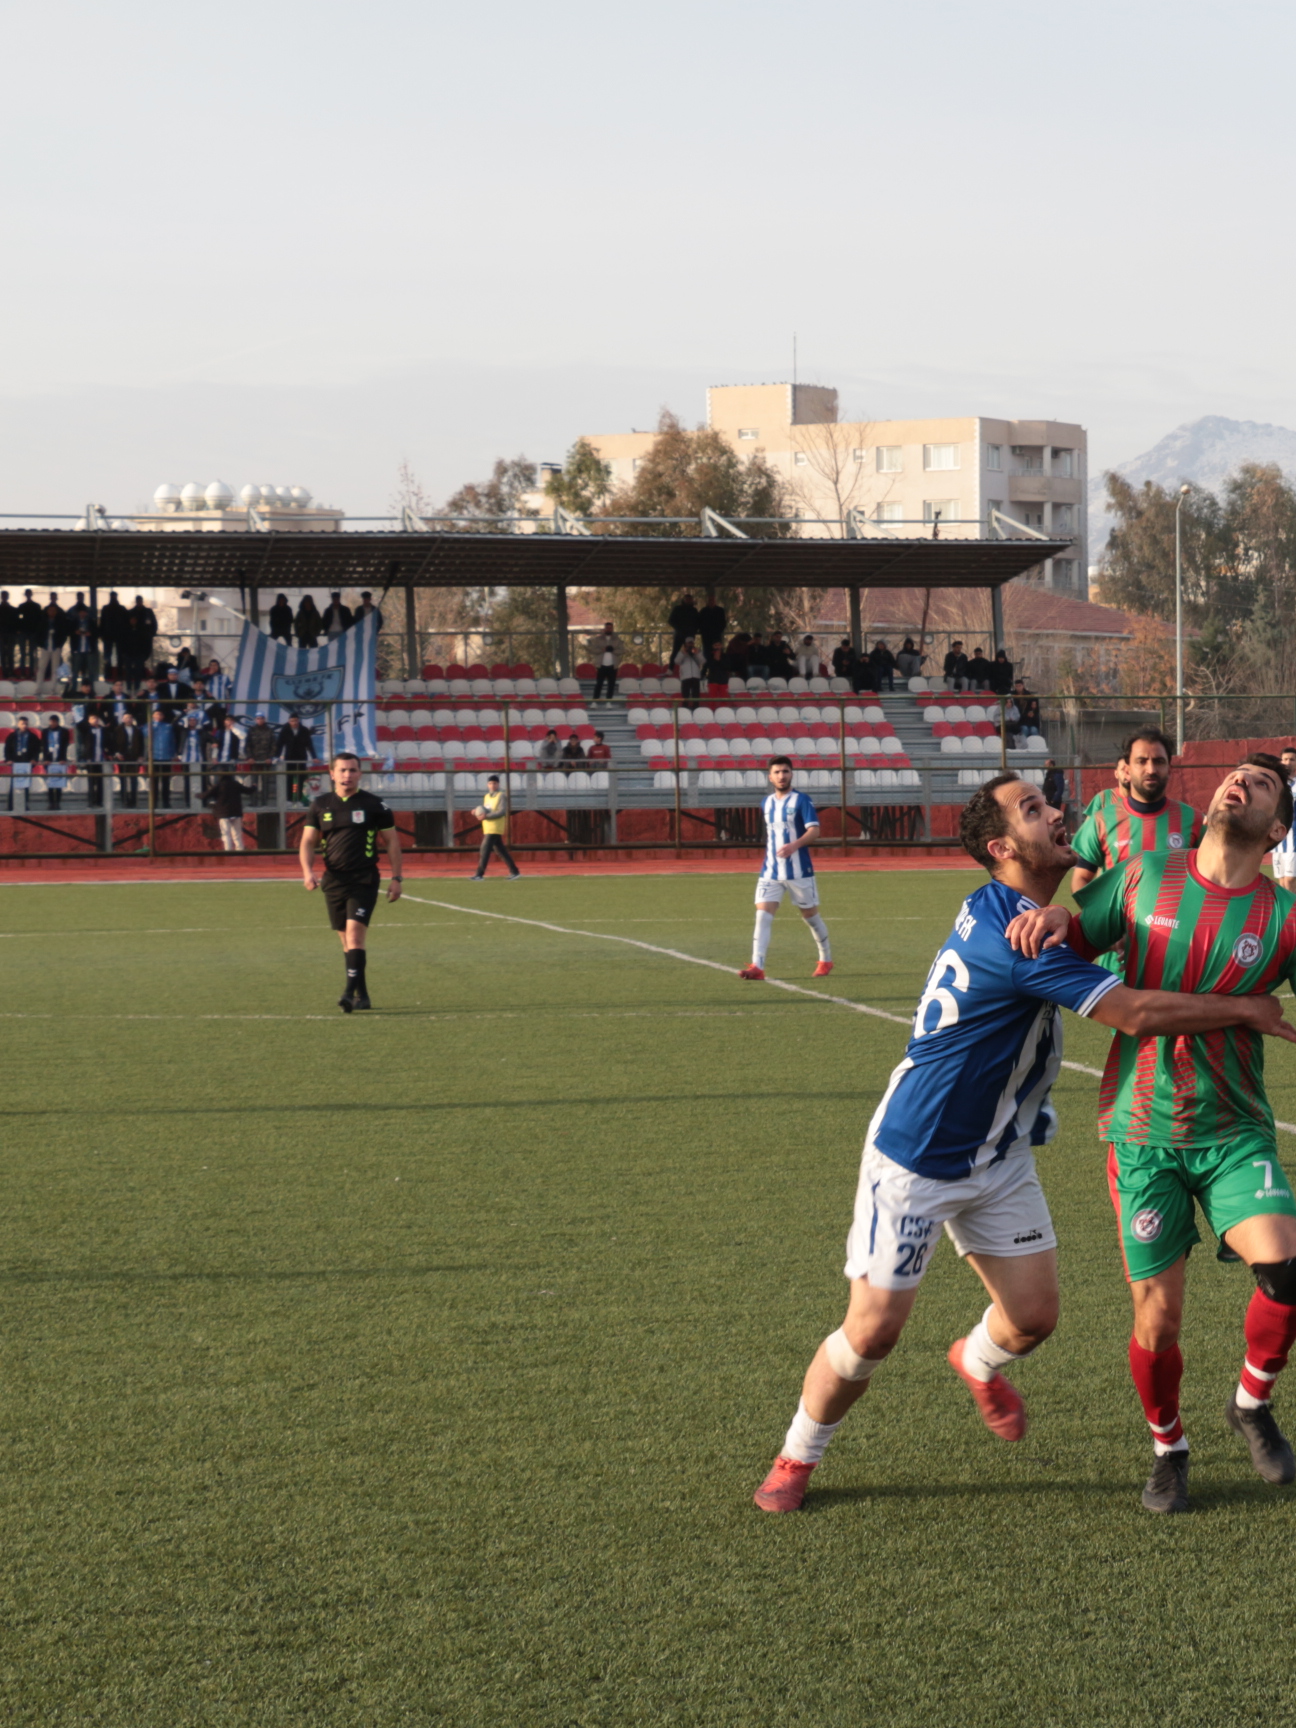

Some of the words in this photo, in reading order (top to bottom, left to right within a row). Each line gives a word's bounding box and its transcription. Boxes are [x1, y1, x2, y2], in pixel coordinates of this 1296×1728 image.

[1154, 915, 1180, 929] LEVANTE
[912, 948, 970, 1040] 6
[1252, 1160, 1272, 1189] 7
